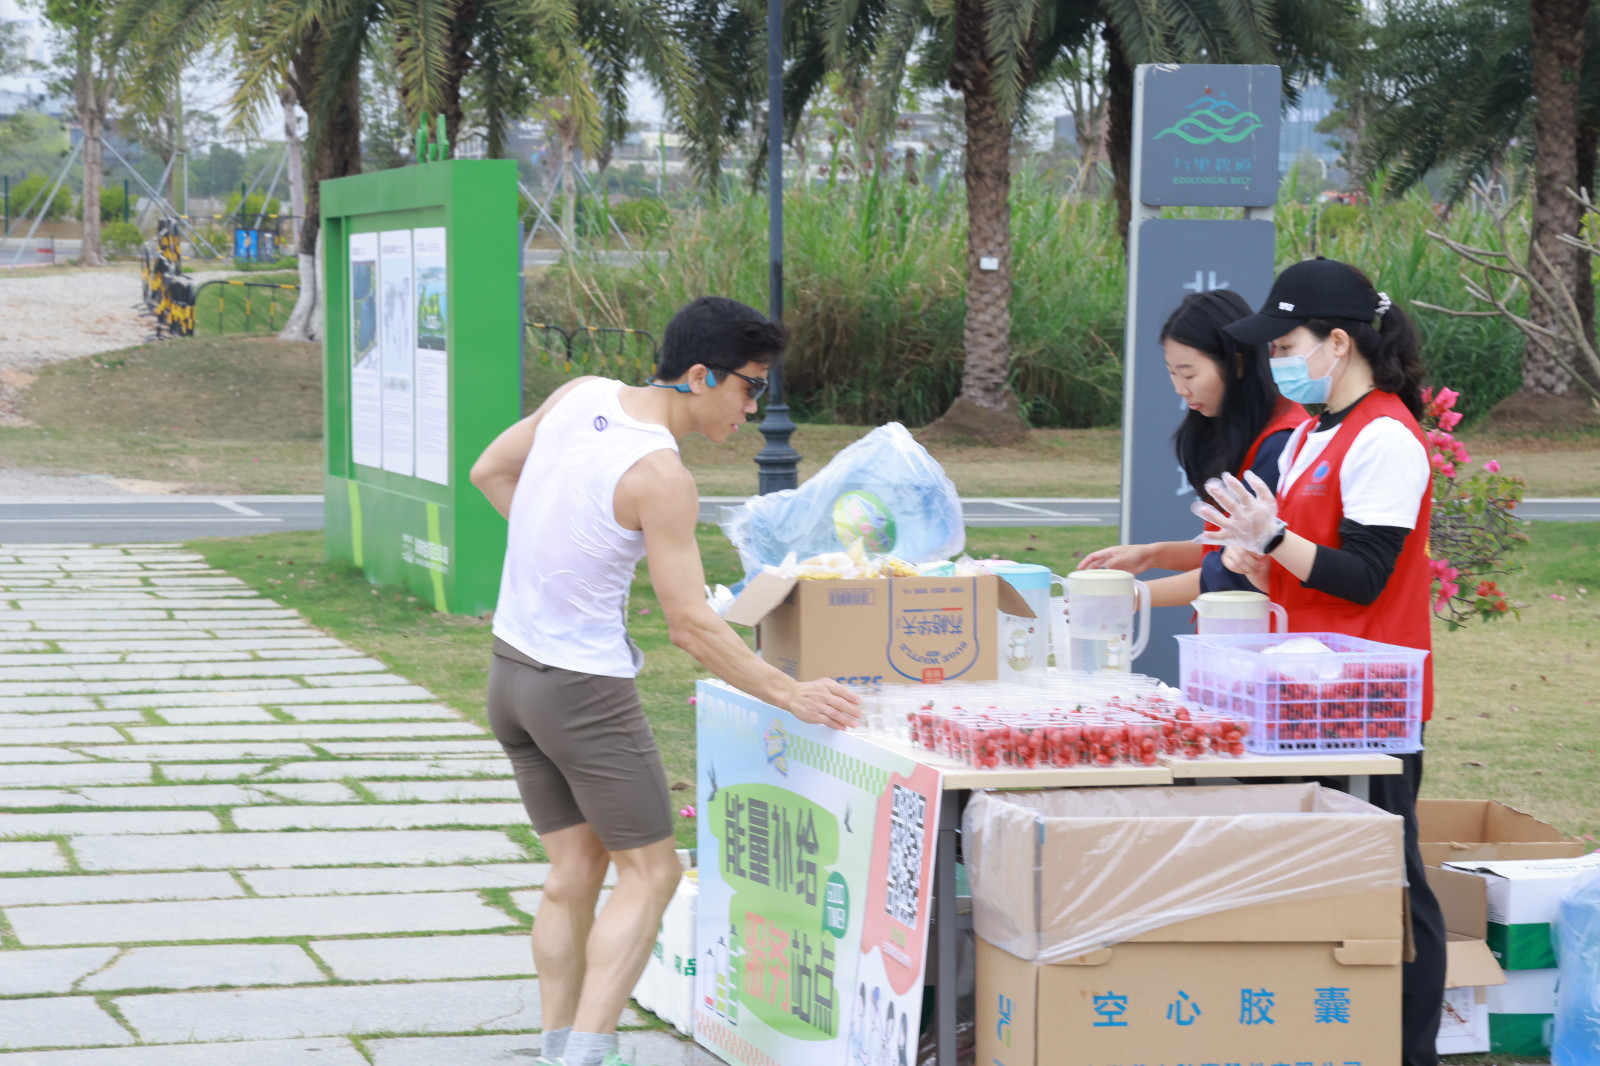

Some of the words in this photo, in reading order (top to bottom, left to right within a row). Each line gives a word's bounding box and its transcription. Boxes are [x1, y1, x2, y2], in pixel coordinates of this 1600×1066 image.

[1172, 176, 1228, 185] ECOLOGICAL
[1230, 176, 1252, 185] BELT
[1173, 156, 1252, 172] 万里碧道
[725, 790, 819, 907] 能量补给
[744, 910, 836, 1037] 服务站点
[1092, 987, 1351, 1027] 空心胶囊
